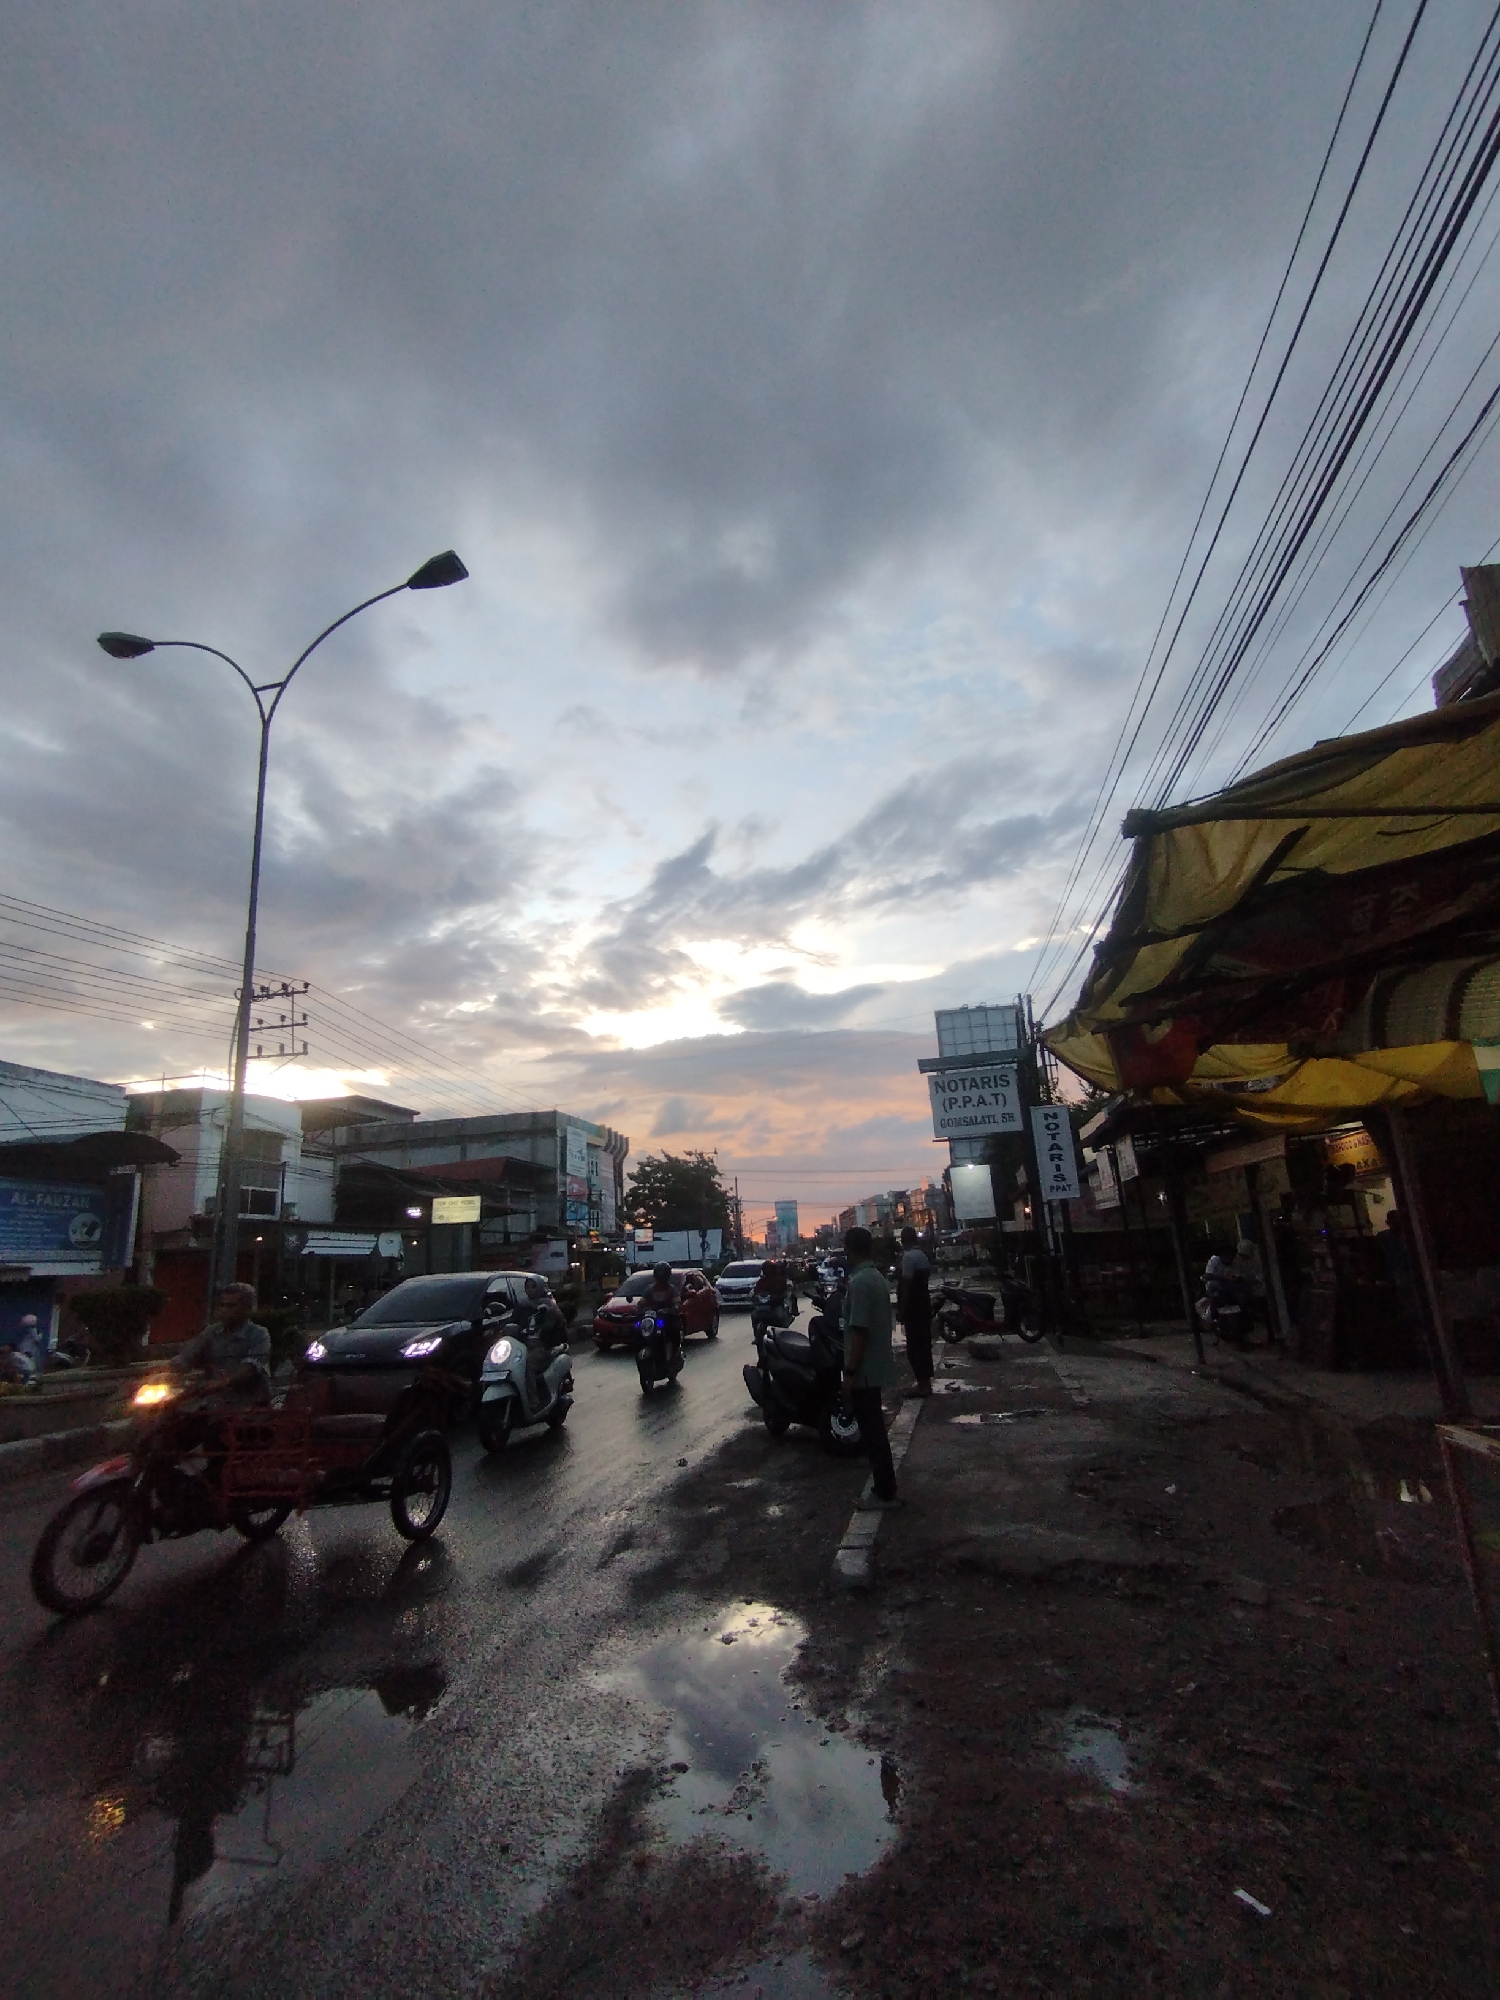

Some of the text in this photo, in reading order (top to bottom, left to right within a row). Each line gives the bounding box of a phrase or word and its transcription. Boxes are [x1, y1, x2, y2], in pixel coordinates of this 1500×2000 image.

[934, 1074, 1010, 1094] NOTARIS
[942, 1092, 1007, 1112] (P.P.A.T)
[1001, 1112, 1016, 1124] SH
[1043, 1112, 1067, 1182] NOTARIS
[1049, 1184, 1073, 1192] PPAT
